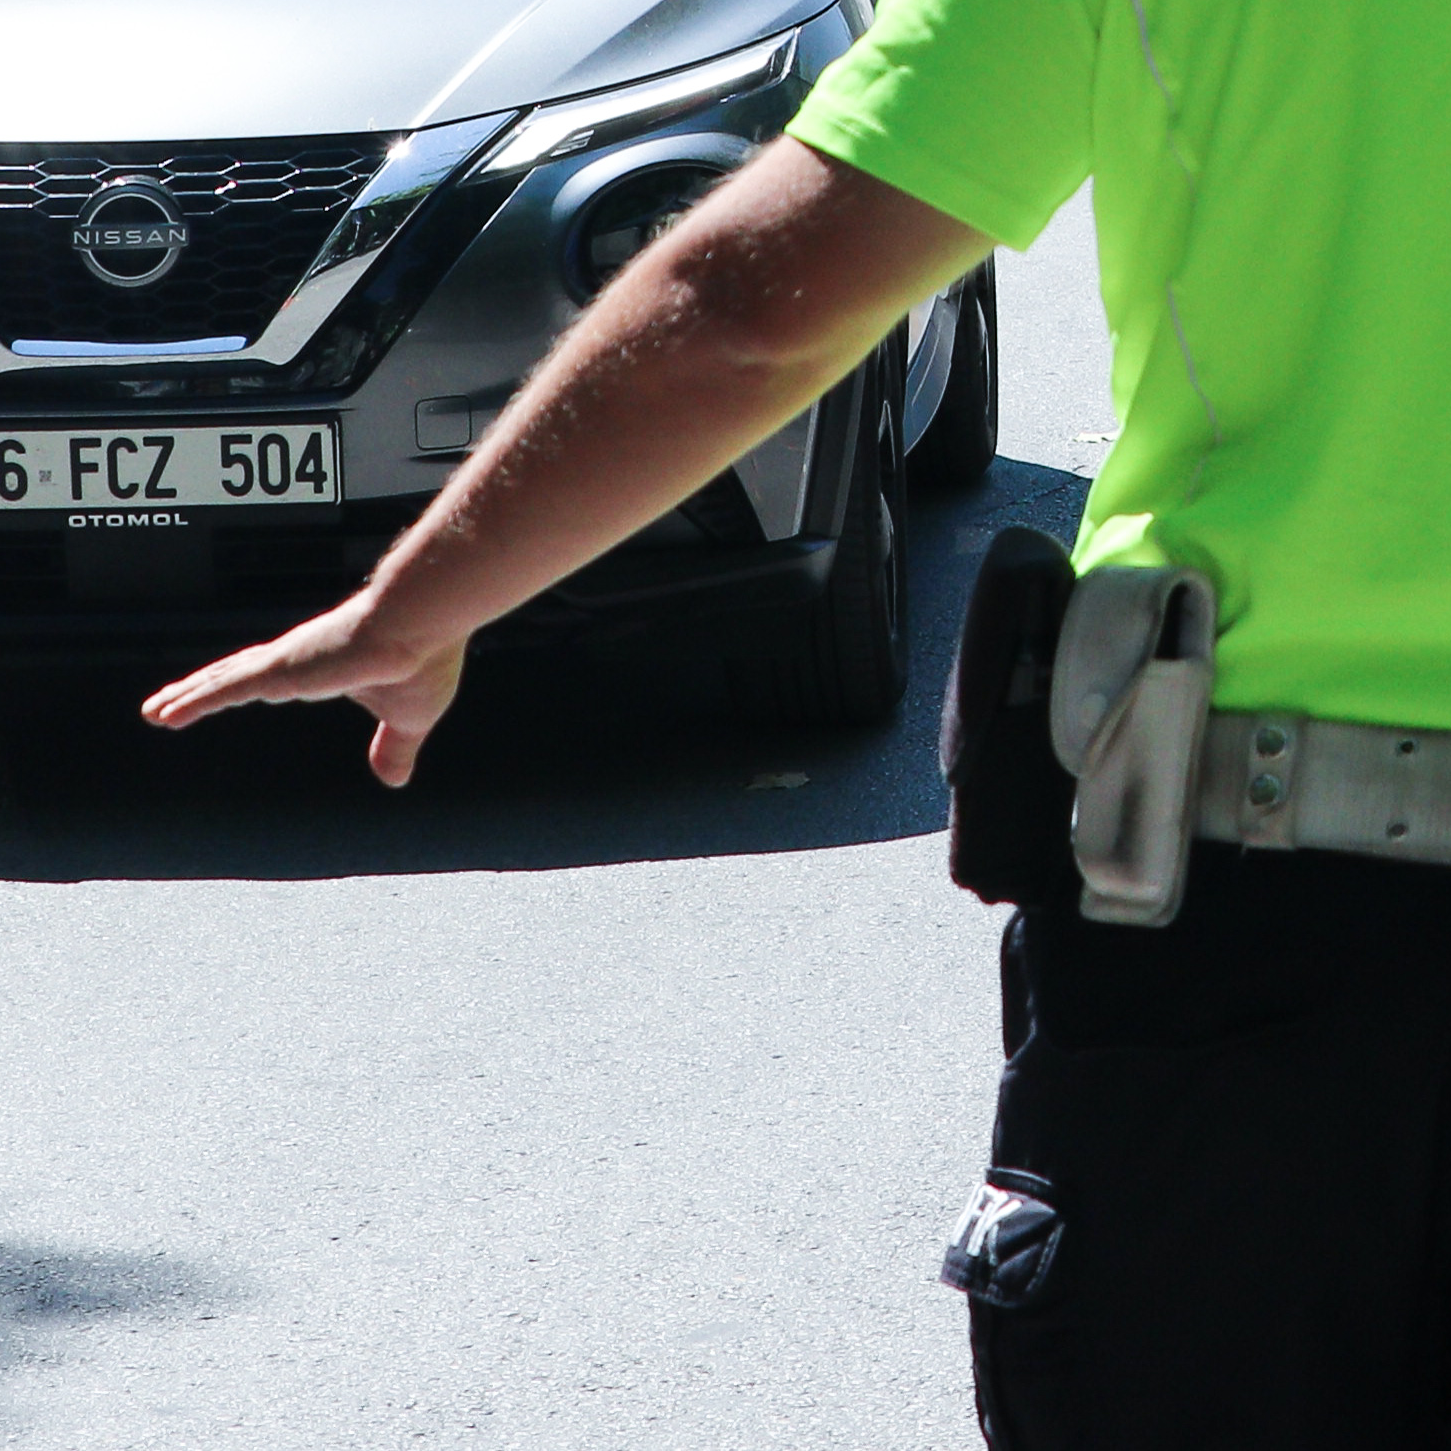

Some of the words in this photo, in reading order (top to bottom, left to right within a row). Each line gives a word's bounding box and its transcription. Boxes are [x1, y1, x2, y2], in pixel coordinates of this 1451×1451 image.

[73, 228, 186, 245] NISSAN
[68, 435, 178, 500] FCZ
[220, 432, 328, 497] 504
[68, 513, 189, 528] OTOMOL
